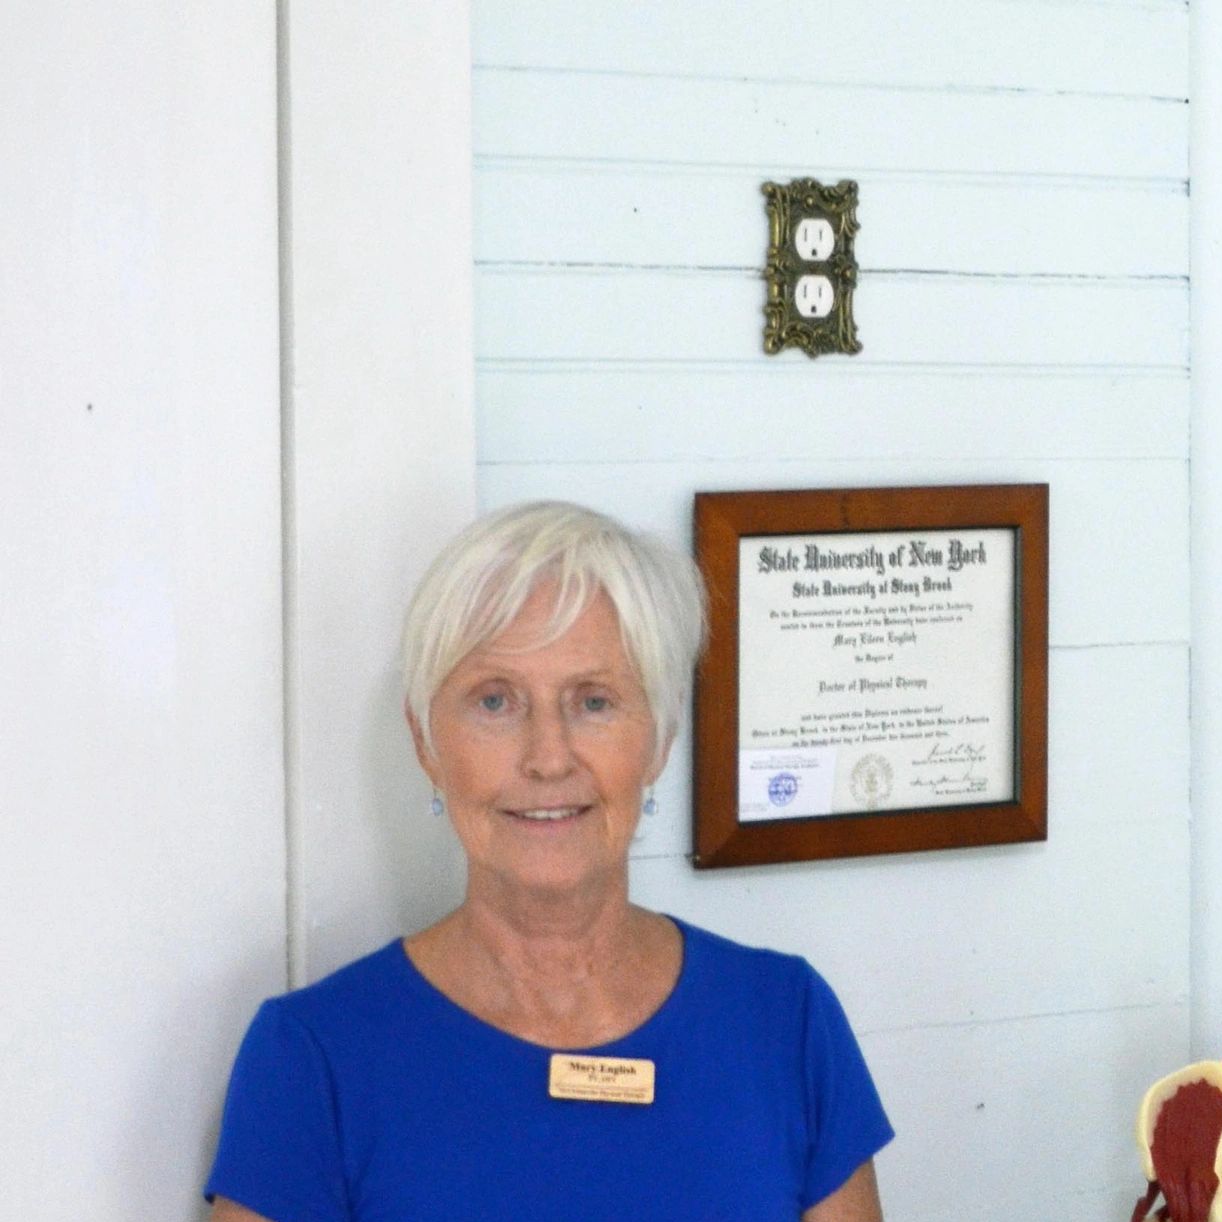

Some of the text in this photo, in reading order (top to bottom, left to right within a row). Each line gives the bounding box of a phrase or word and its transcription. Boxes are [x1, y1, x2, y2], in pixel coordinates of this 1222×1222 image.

[758, 539, 987, 577] State University of New York
[792, 581, 819, 598] State
[823, 579, 876, 599] University
[891, 578, 920, 597] Stony
[923, 576, 952, 592] Brook
